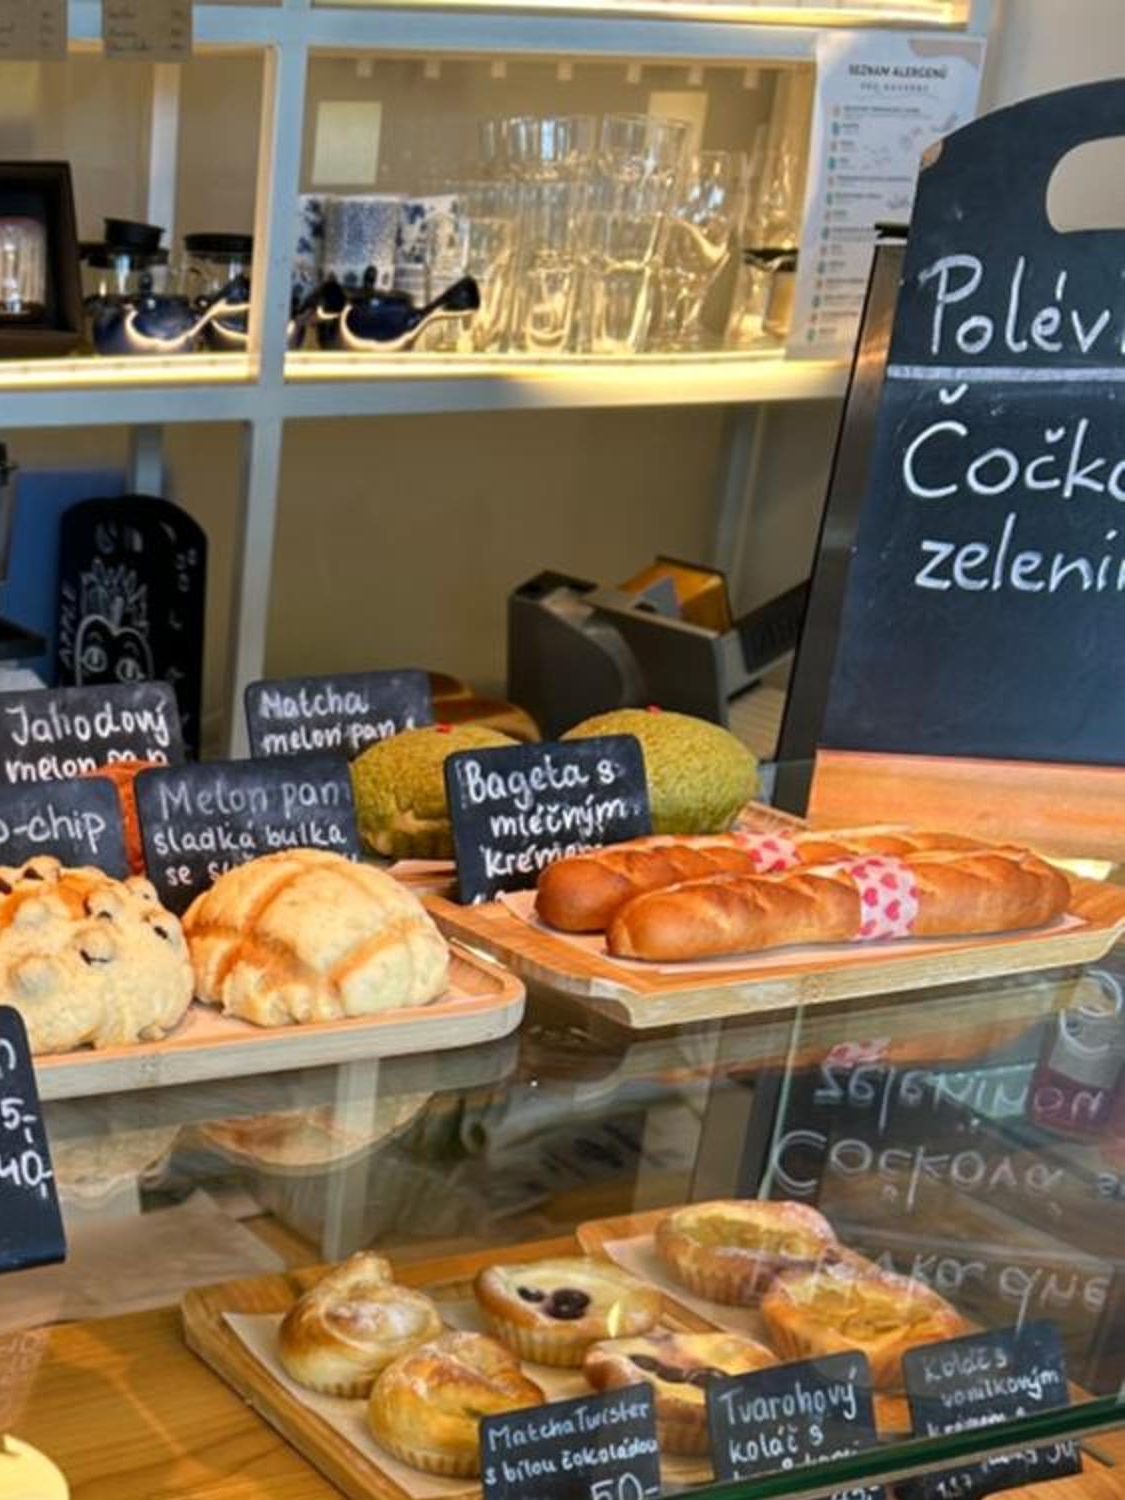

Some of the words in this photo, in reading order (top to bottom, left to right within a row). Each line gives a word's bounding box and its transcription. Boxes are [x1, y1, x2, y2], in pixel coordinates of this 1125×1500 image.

[919, 254, 1125, 355] Polév
[261, 724, 342, 756] melon
[158, 774, 268, 821] Melon
[281, 781, 339, 819] pan
[464, 754, 589, 812] Bageta
[597, 759, 615, 784] s
[153, 820, 257, 855] sladká
[165, 864, 192, 886] se
[718, 1365, 858, 1425] Tvarohový
[729, 1423, 799, 1465] koláč
[809, 1423, 824, 1446] s
[484, 1466, 497, 1486] s
